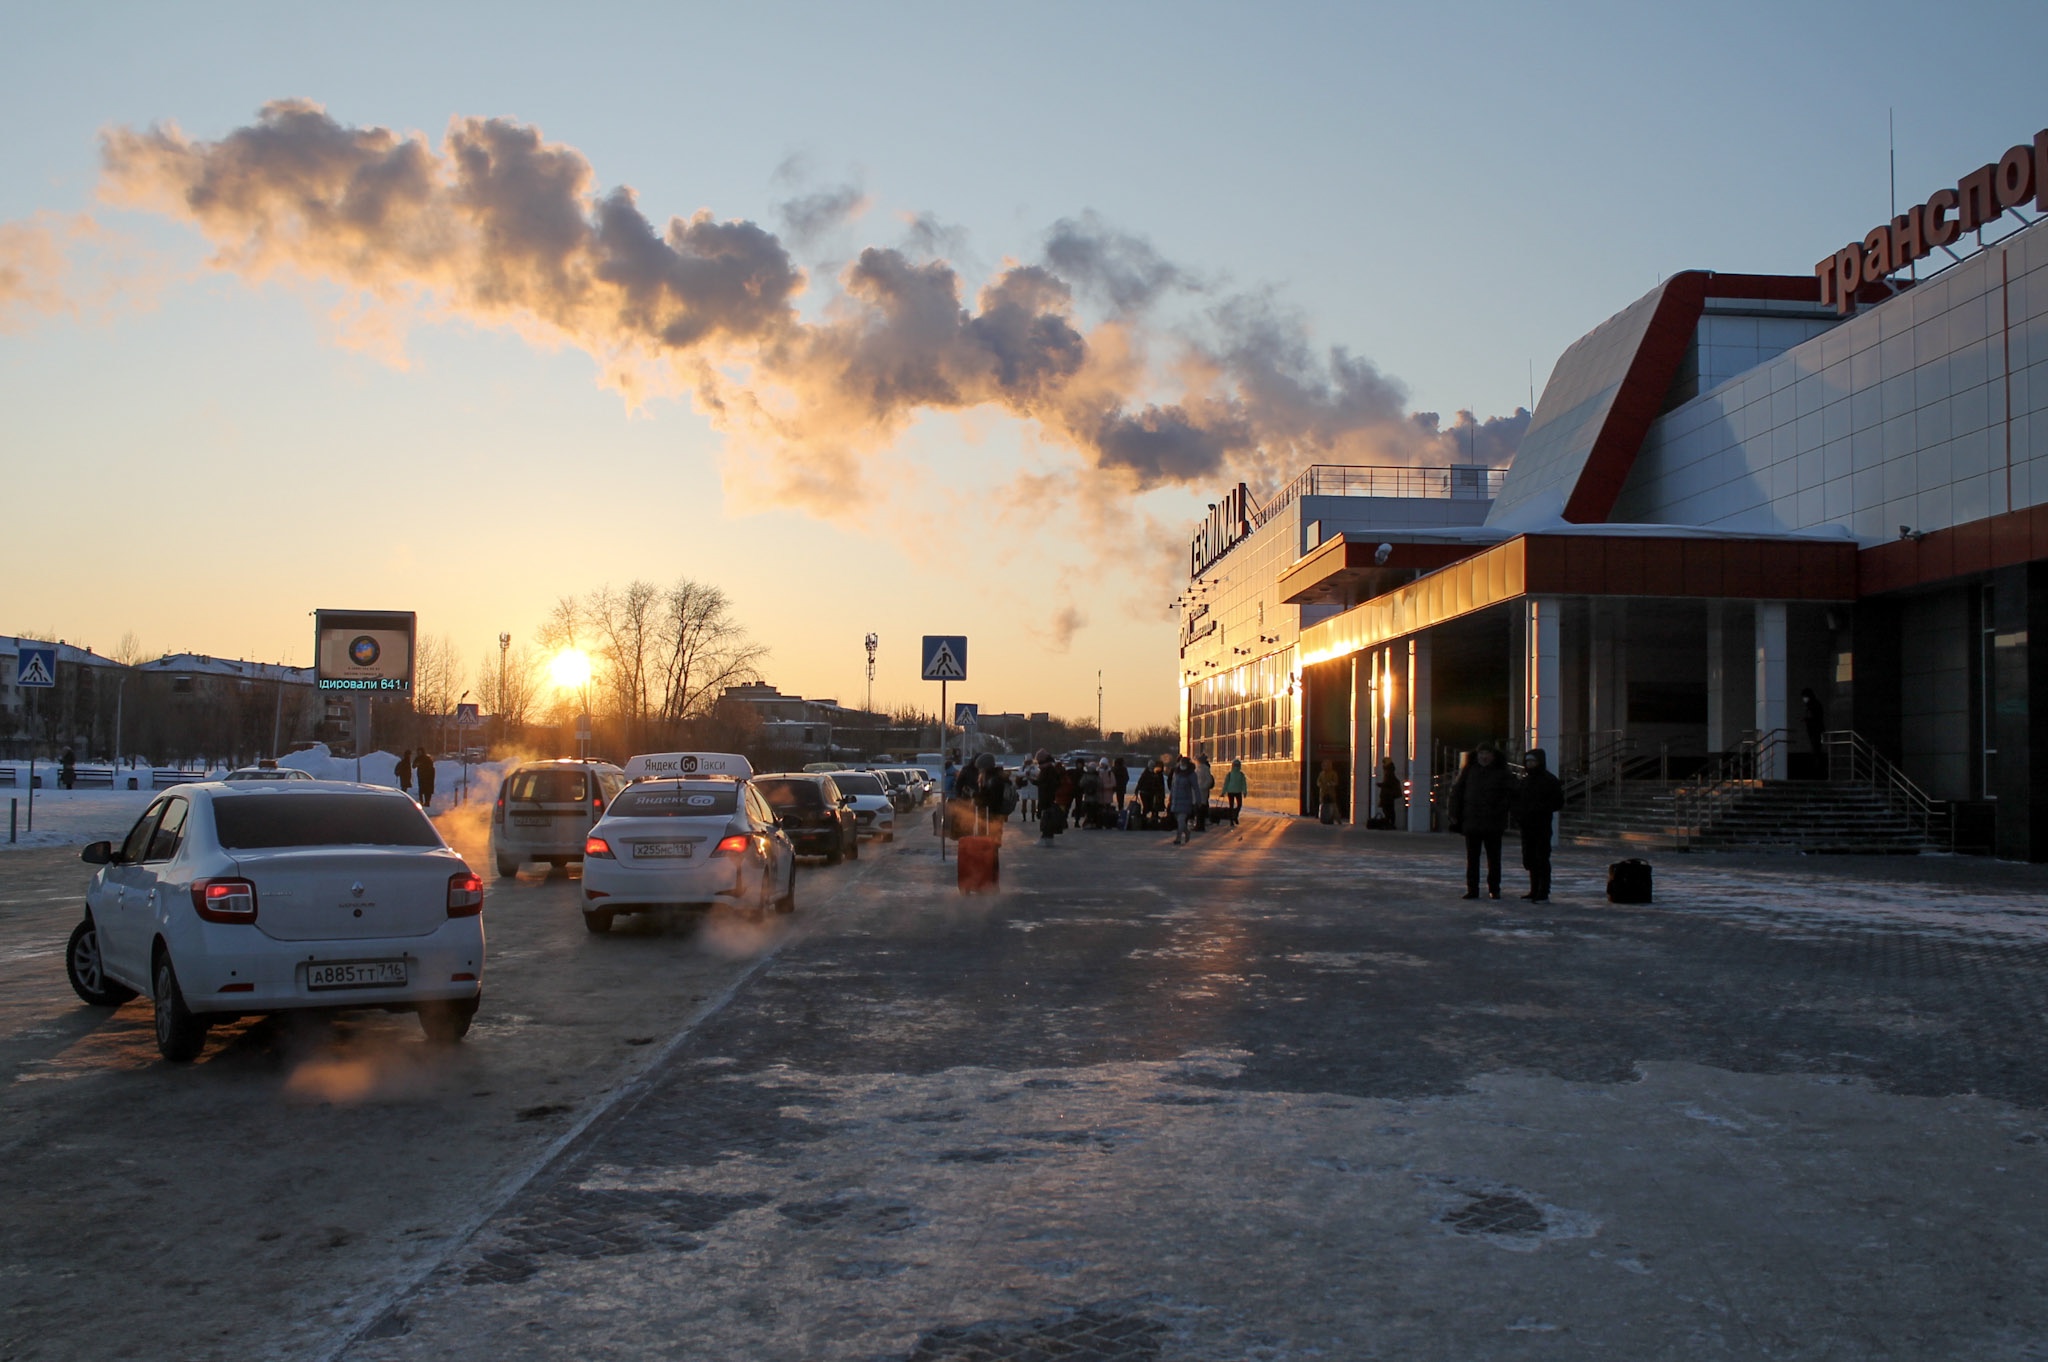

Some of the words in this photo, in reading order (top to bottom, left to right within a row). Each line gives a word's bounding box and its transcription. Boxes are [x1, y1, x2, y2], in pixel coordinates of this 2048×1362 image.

[1189, 483, 1250, 580] TERMINAL
[644, 759, 678, 771] Яндекс
[682, 757, 697, 772] Go
[700, 759, 726, 770] Такси
[635, 795, 686, 805] Яндекс
[689, 796, 713, 805] Go
